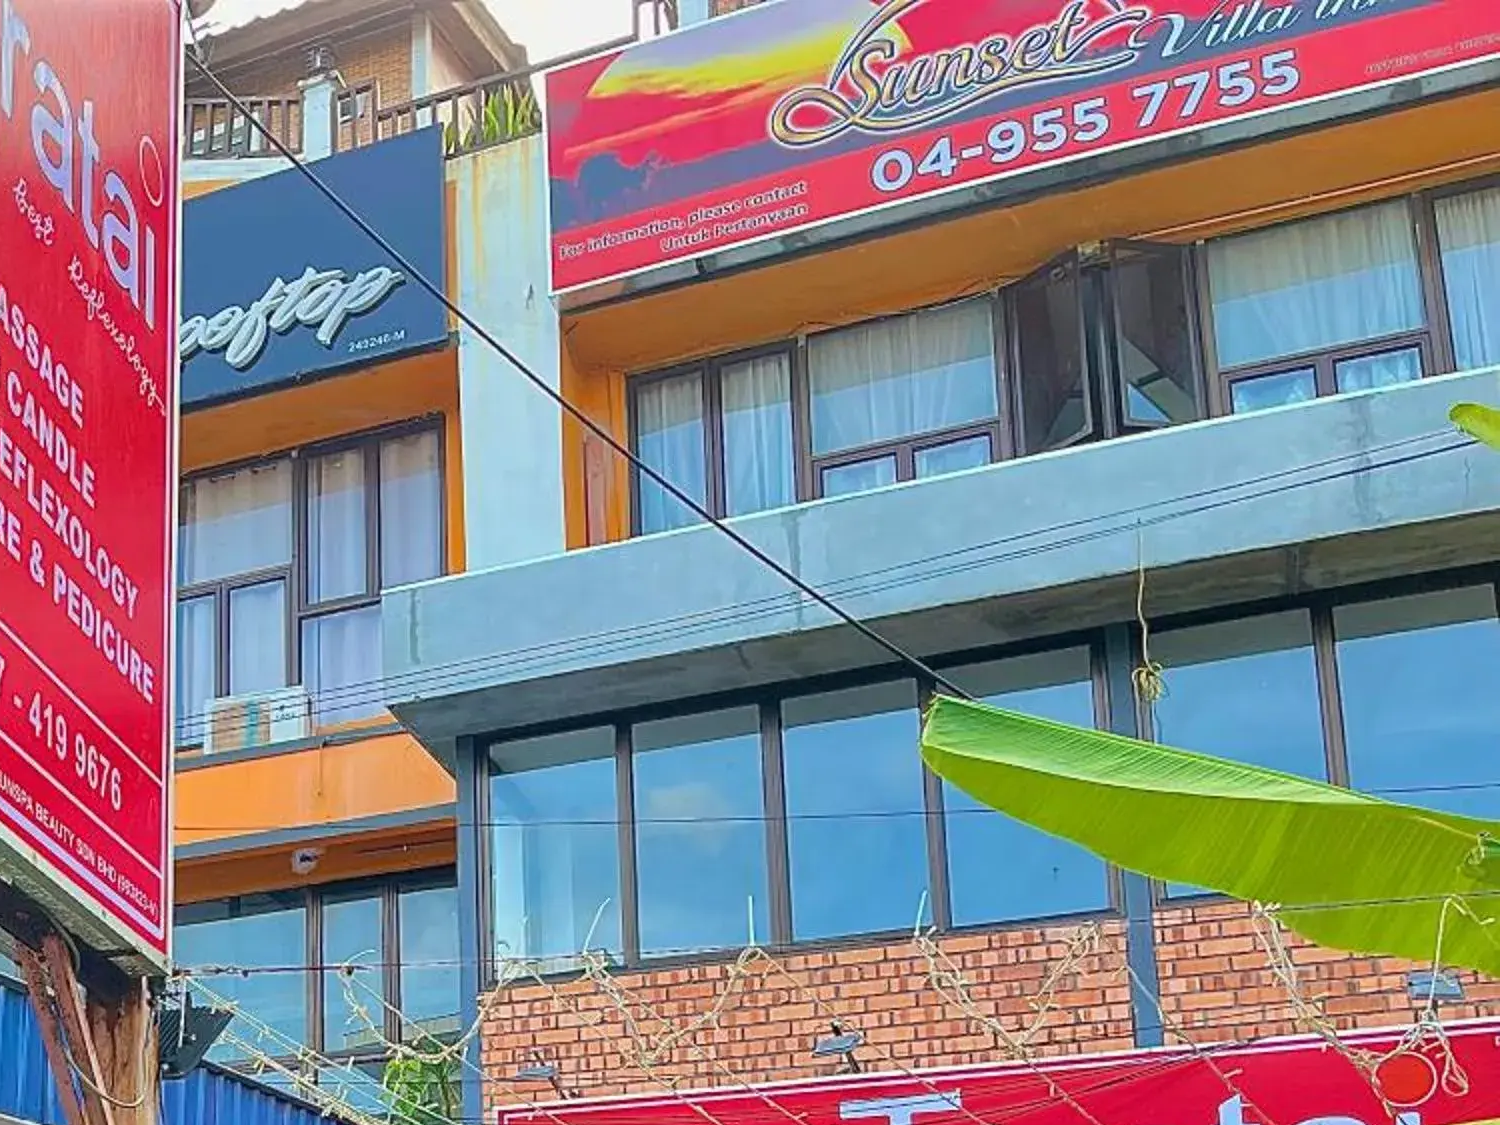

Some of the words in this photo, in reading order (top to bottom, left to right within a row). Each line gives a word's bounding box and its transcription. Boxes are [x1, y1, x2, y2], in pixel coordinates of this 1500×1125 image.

[770, 0, 1112, 146] Sunset
[1128, 0, 1301, 57] Villa
[870, 97, 1110, 192] 04-955
[1133, 49, 1300, 127] 7755
[660, 230, 710, 252] Untuk
[689, 200, 742, 226] please
[744, 180, 807, 208] contact
[6, 370, 96, 509] CANDLE
[29, 539, 46, 588] &
[53, 562, 154, 704] PEDICURE
[28, 691, 68, 761] 419
[74, 732, 121, 812] 9676
[35, 802, 75, 848] BEAUTY
